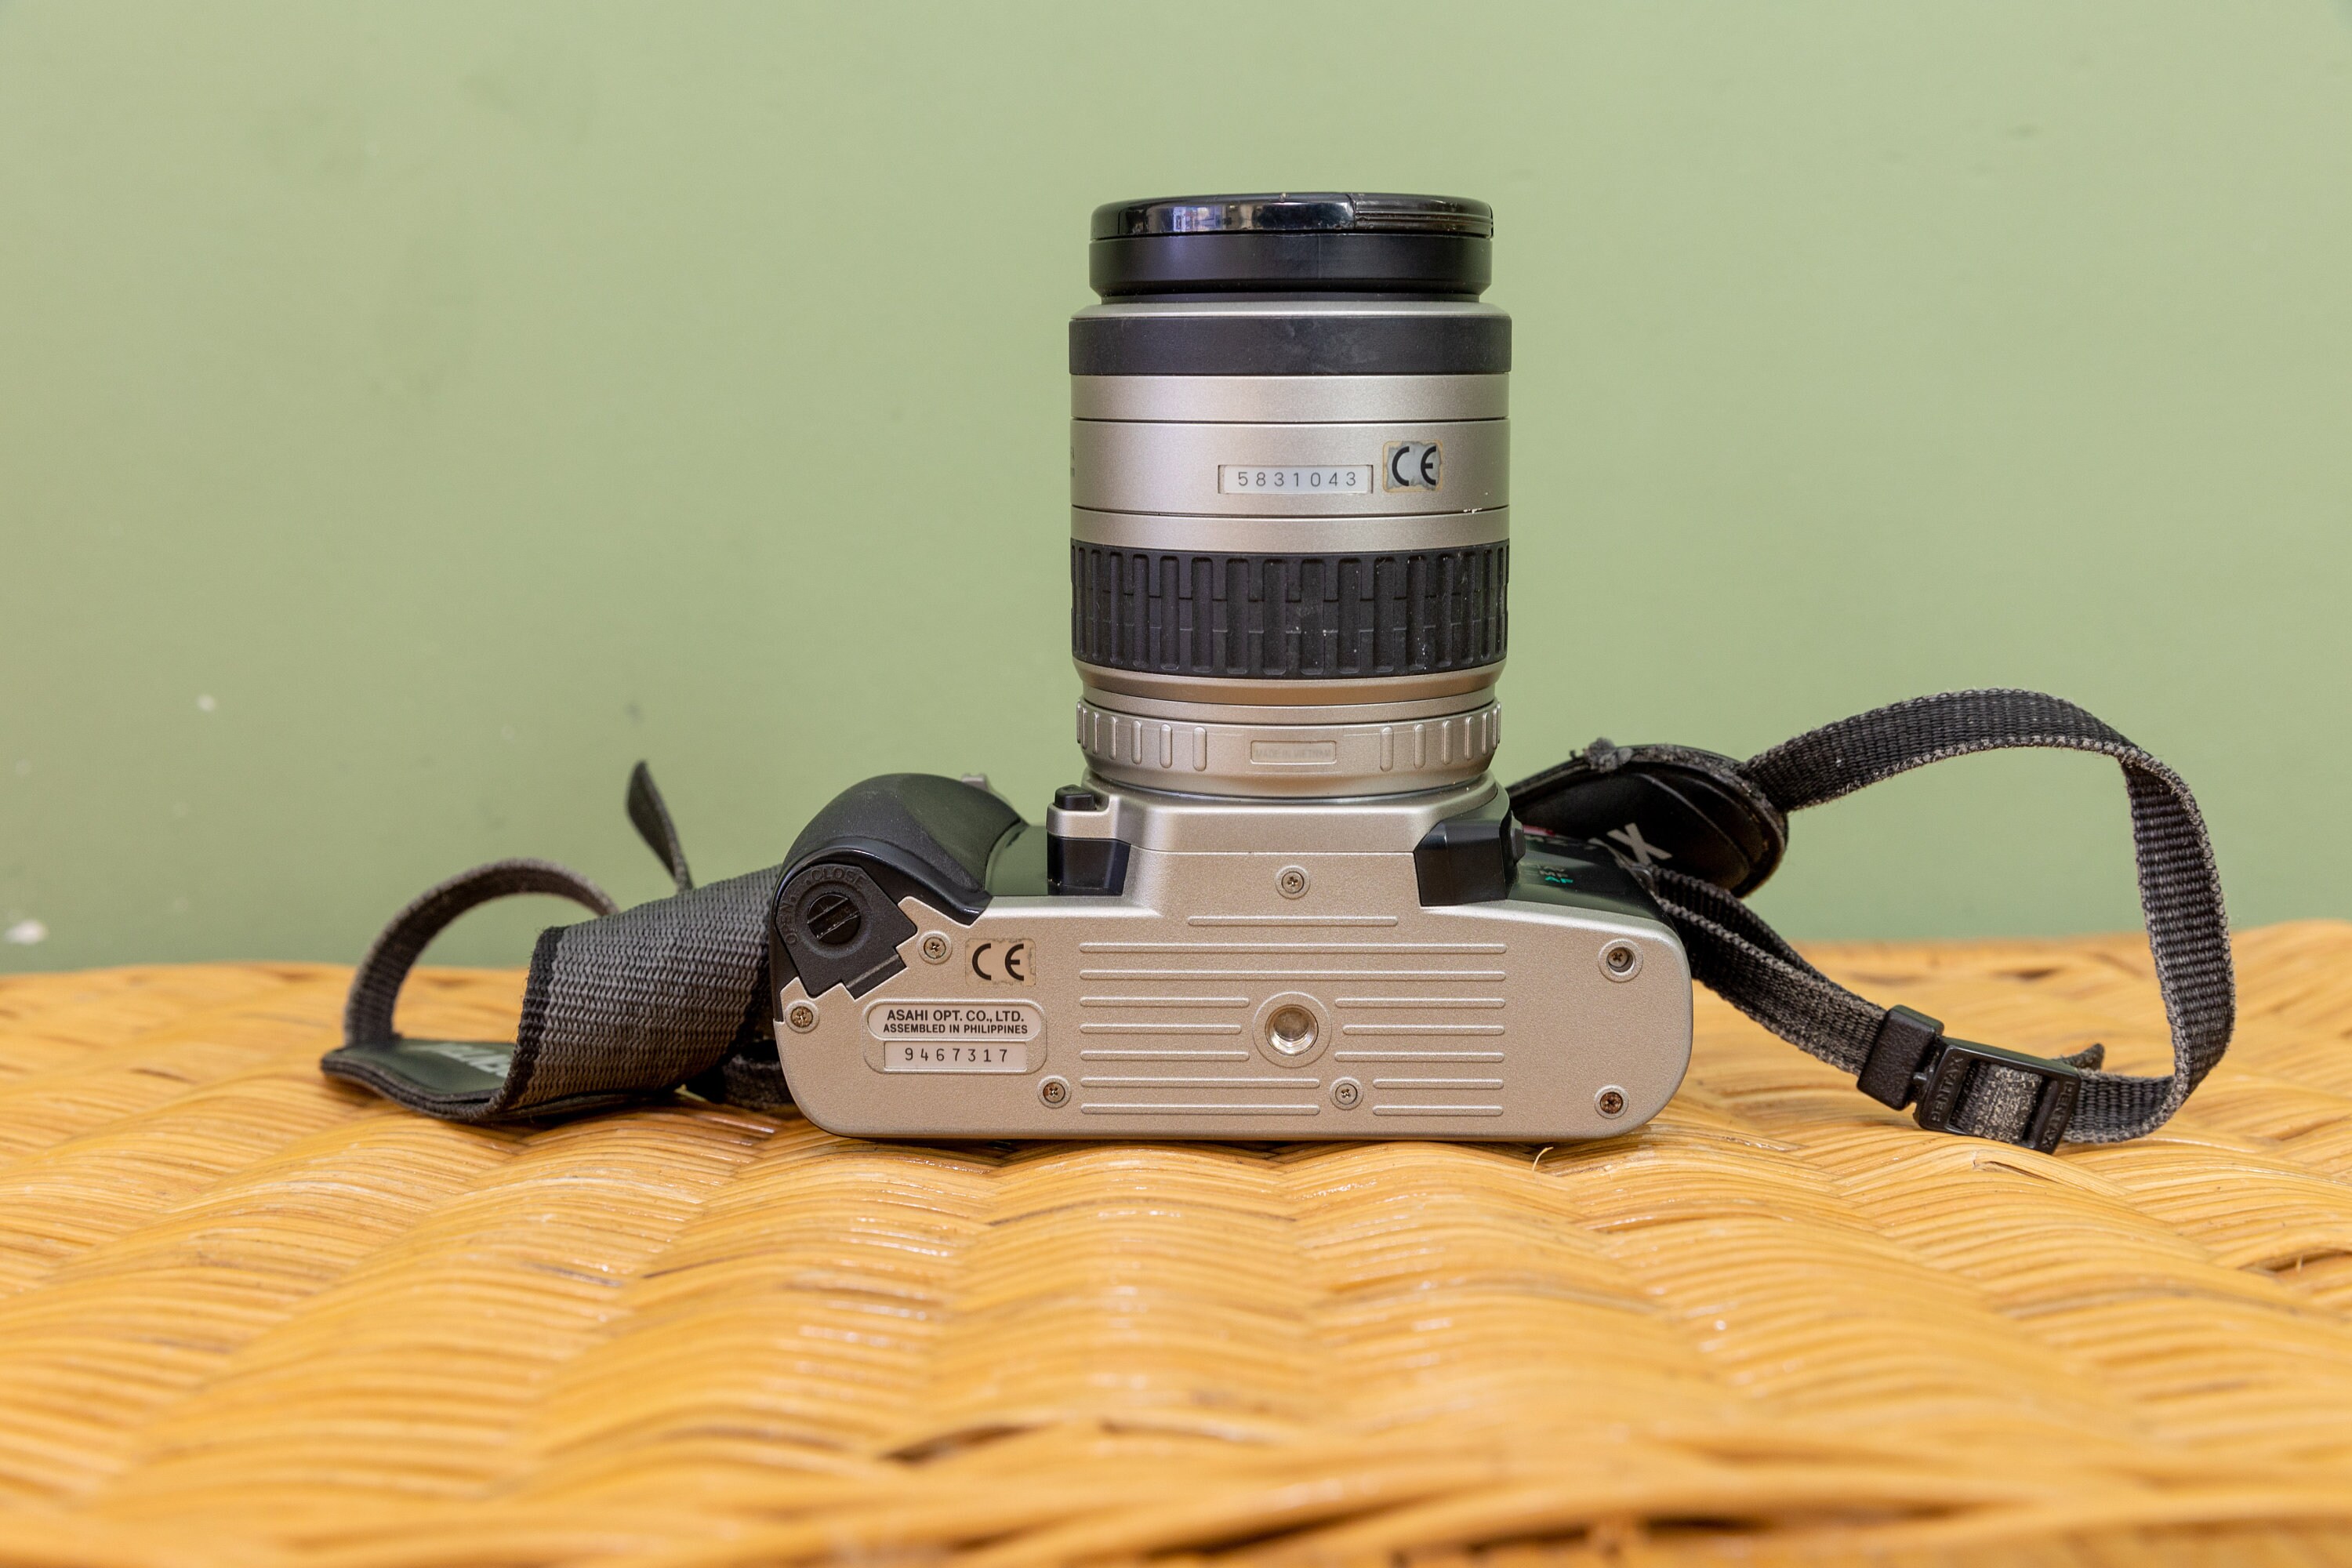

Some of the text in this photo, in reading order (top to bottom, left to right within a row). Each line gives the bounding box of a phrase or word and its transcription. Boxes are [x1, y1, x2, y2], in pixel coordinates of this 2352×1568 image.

[1391, 445, 1437, 487] CE
[1237, 471, 1357, 488] 5831043
[810, 867, 868, 887] CLOSE
[971, 942, 1025, 982] CE
[887, 1009, 1025, 1023] ASAHI OPT. CO., LTD.
[883, 1024, 1029, 1034] ASSEMBLED IN PHILIPPINES
[905, 1047, 1008, 1063] 9467317
[1930, 1056, 1964, 1123] PENTAX
[2042, 1080, 2076, 1149] PENTAX
